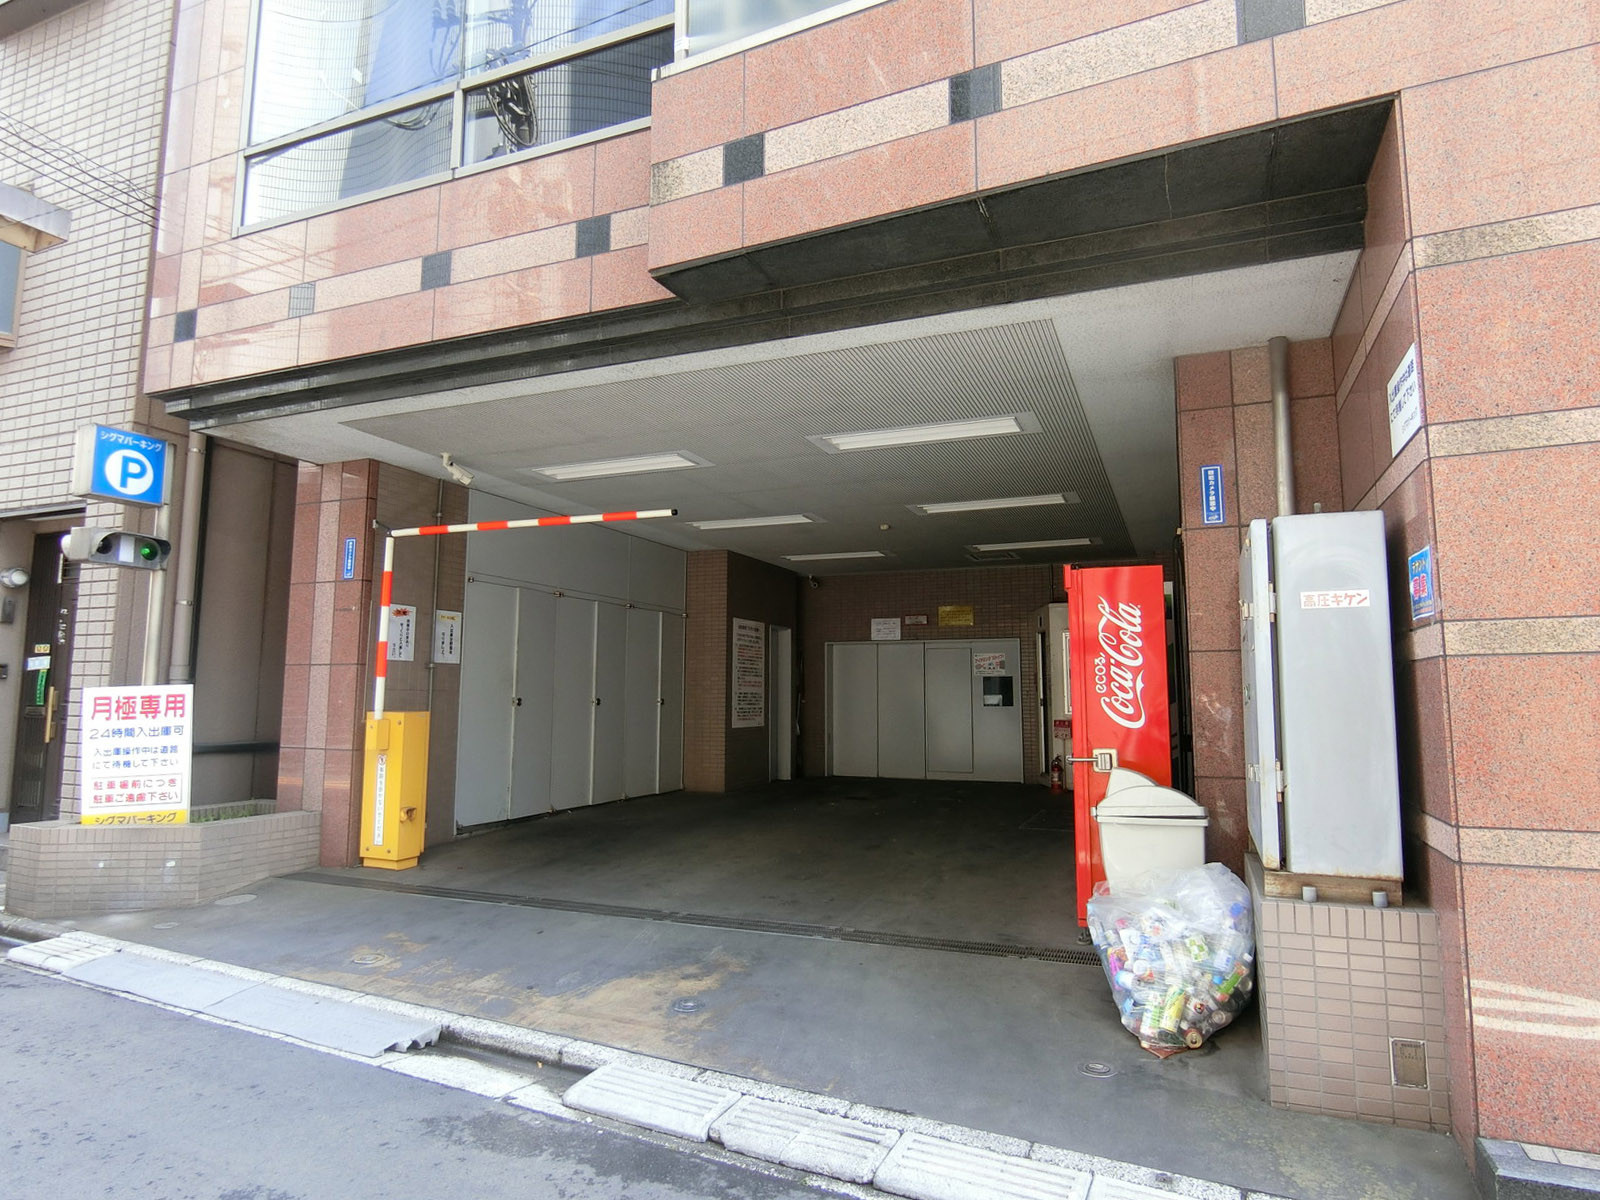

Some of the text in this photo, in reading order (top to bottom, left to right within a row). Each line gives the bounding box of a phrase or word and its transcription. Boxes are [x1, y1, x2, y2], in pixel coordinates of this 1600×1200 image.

[100, 430, 162, 453] シグマパーキング
[119, 455, 148, 488] P
[1303, 592, 1368, 607] 高圧キケン
[1097, 595, 1146, 729] Coca-Cola
[91, 693, 186, 721] 月極専用
[94, 745, 179, 757] 入出庫操作中は道路
[92, 758, 179, 770] にて待機して下さい
[93, 778, 178, 791] 駐車場前につき
[93, 791, 178, 804] 駐車ご遠慮下さい
[95, 812, 177, 825] シグマパーキング
